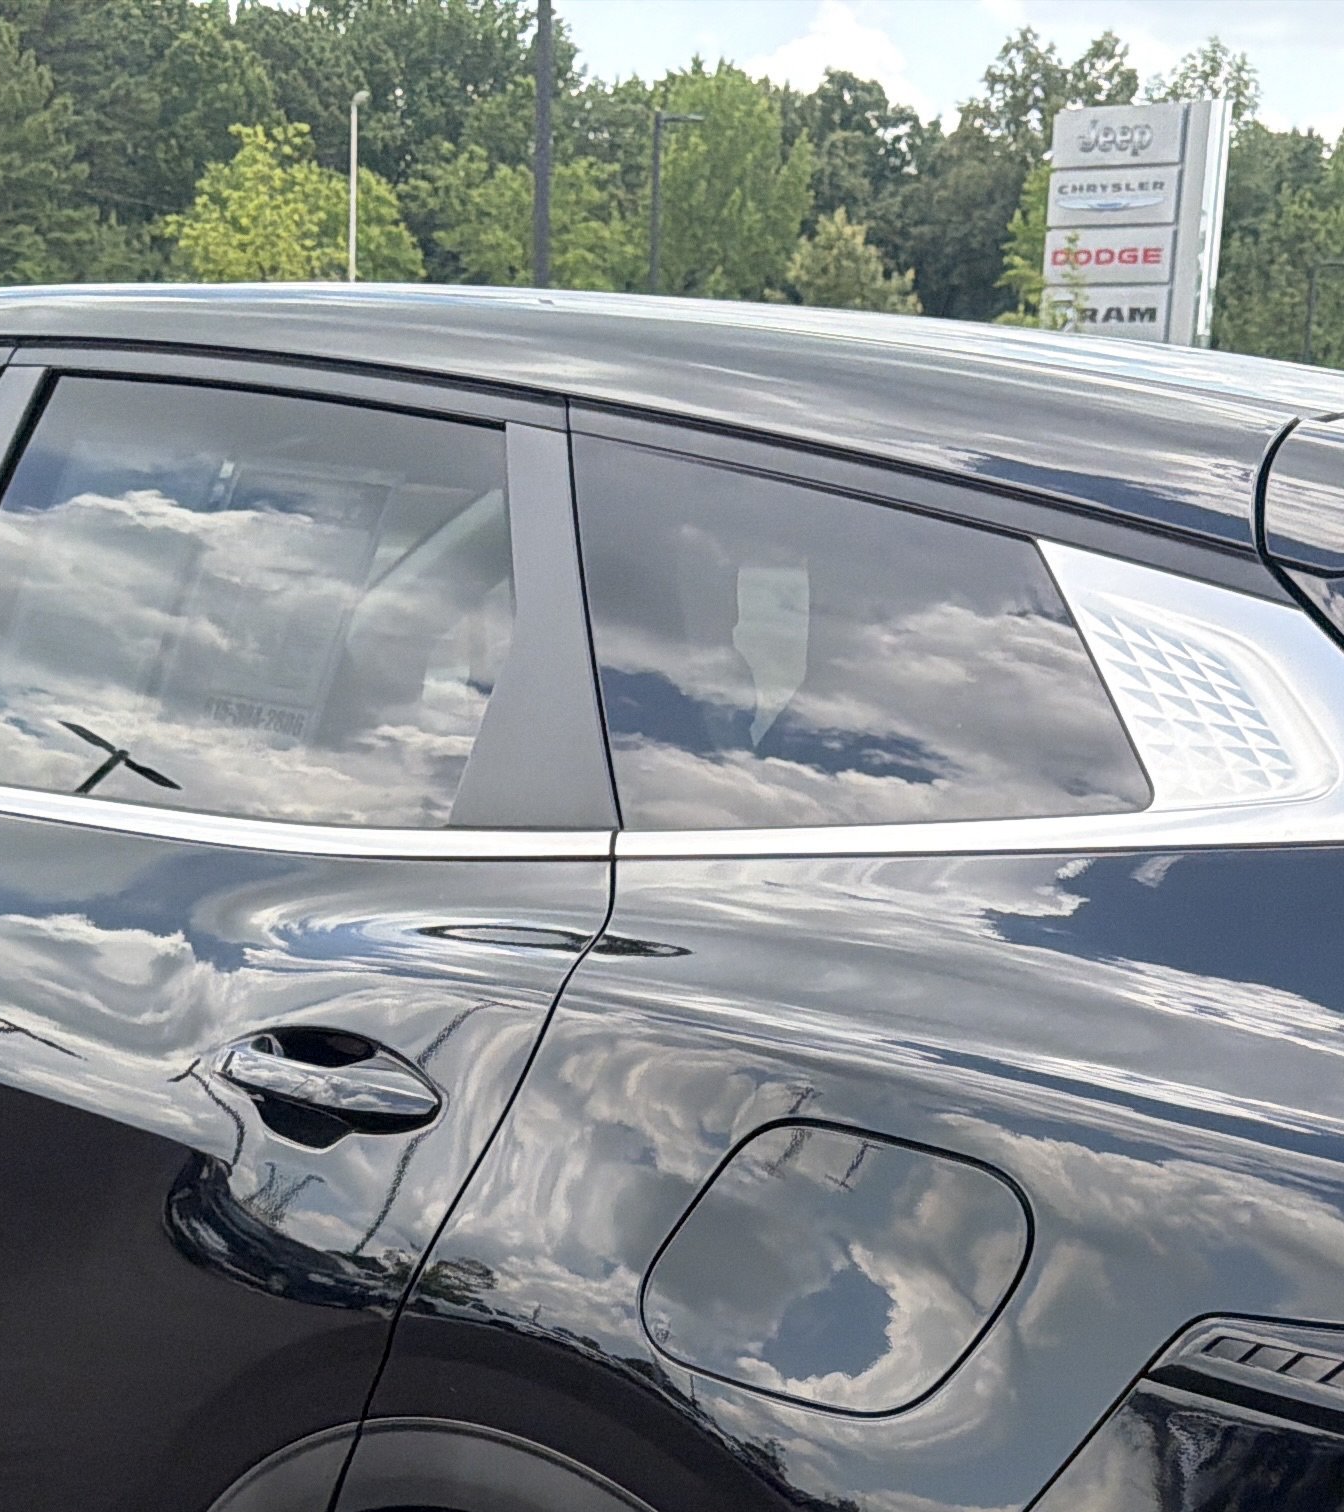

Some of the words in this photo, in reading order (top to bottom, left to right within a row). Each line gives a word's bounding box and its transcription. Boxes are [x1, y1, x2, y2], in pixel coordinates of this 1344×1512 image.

[1078, 119, 1153, 157] Jeep
[1057, 181, 1165, 195] CHRYSLER
[1051, 247, 1164, 266] DODGE
[1079, 306, 1158, 324] RAM
